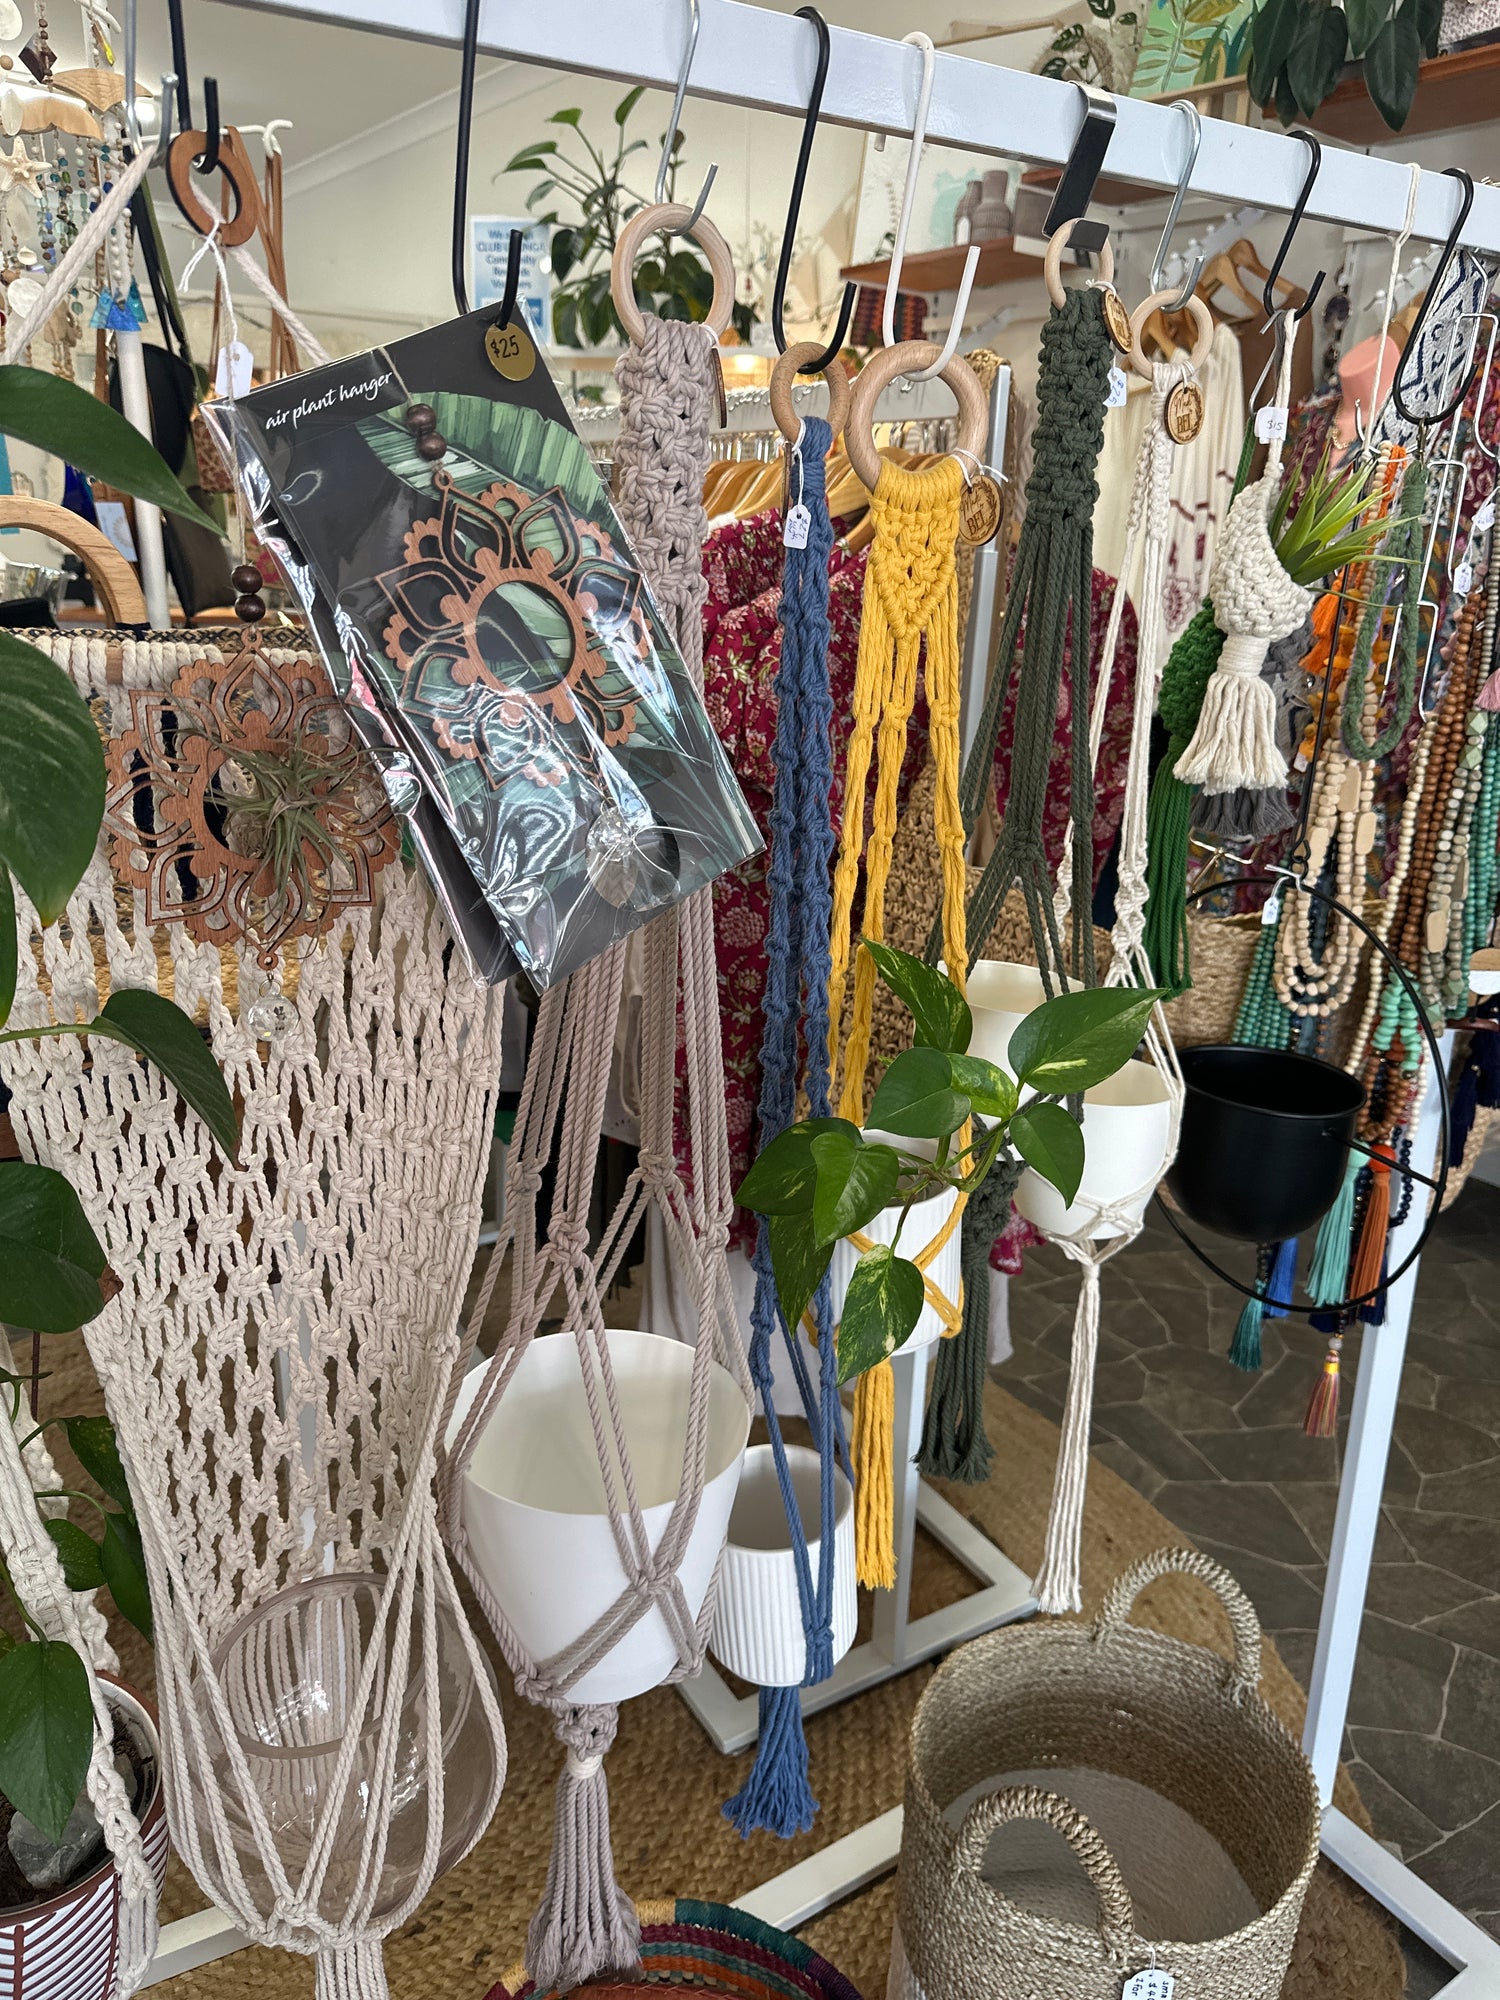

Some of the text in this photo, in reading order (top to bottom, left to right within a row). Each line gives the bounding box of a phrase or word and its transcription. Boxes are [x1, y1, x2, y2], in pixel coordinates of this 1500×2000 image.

[490, 335, 520, 359] $25
[265, 371, 393, 430] air plant hanger
[1266, 419, 1284, 431] $15
[1146, 1982, 1158, 2000] $4
